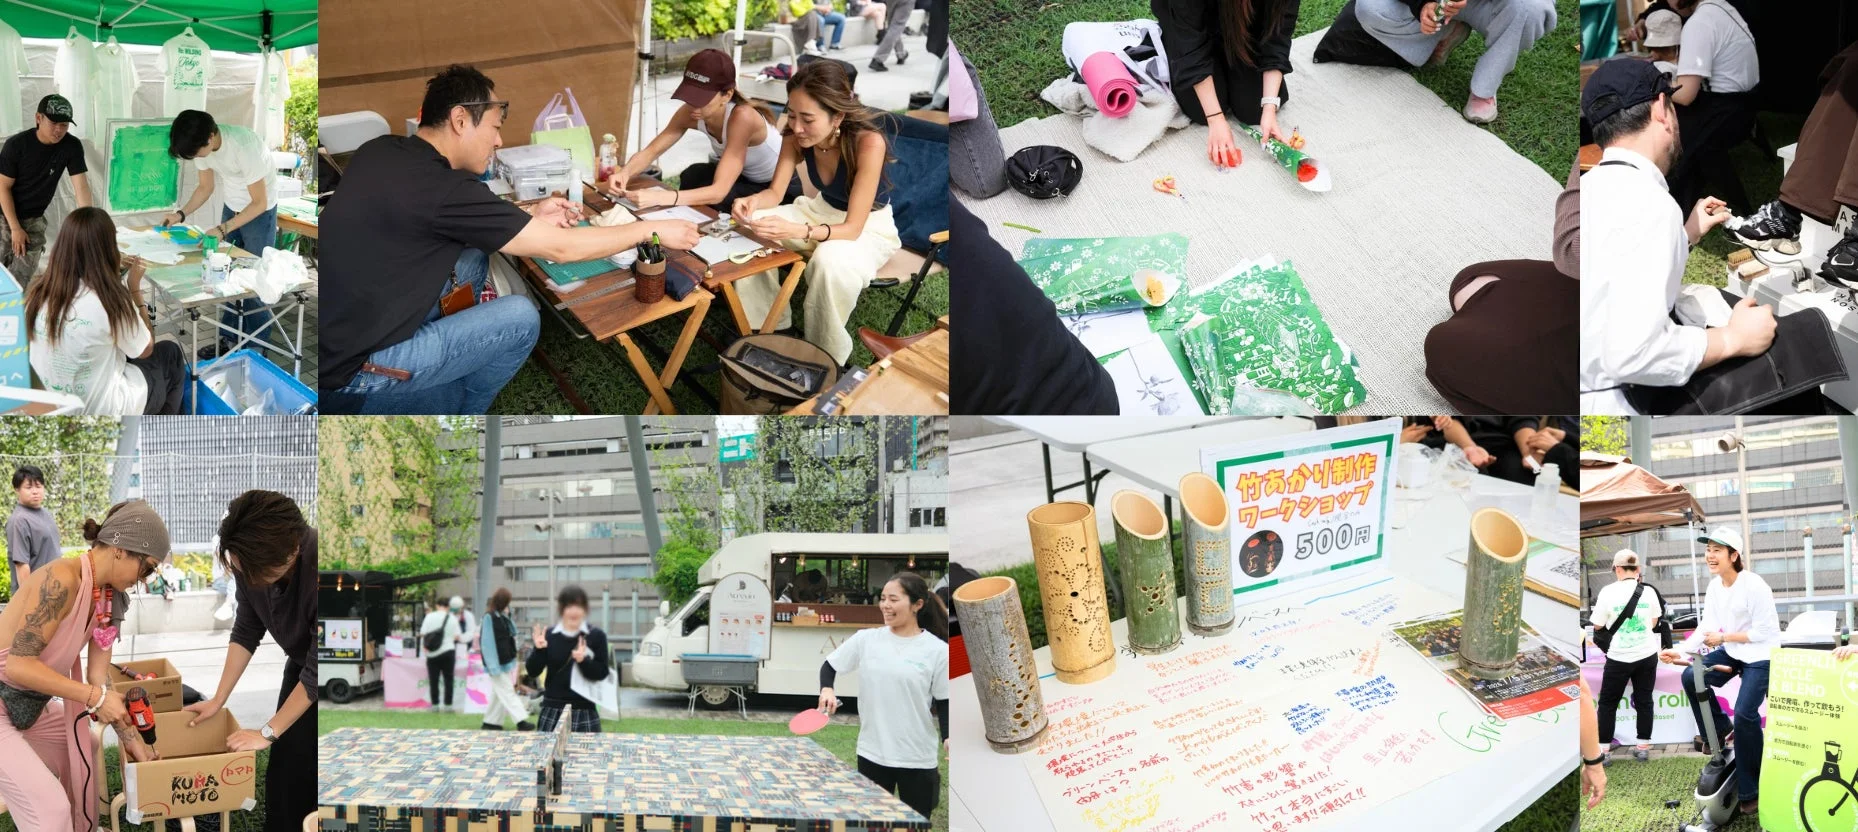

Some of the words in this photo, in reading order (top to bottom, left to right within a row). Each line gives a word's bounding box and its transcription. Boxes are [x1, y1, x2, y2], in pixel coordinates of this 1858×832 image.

[1236, 452, 1378, 503] 竹あかり制作
[1238, 481, 1375, 529] ワークショップ
[1294, 523, 1371, 560] 500円
[1771, 666, 1814, 683] CYCLE
[1781, 681, 1826, 698] BLEND
[226, 764, 254, 777] トマト
[171, 771, 220, 792] KUMA
[171, 787, 220, 805] MOTO
